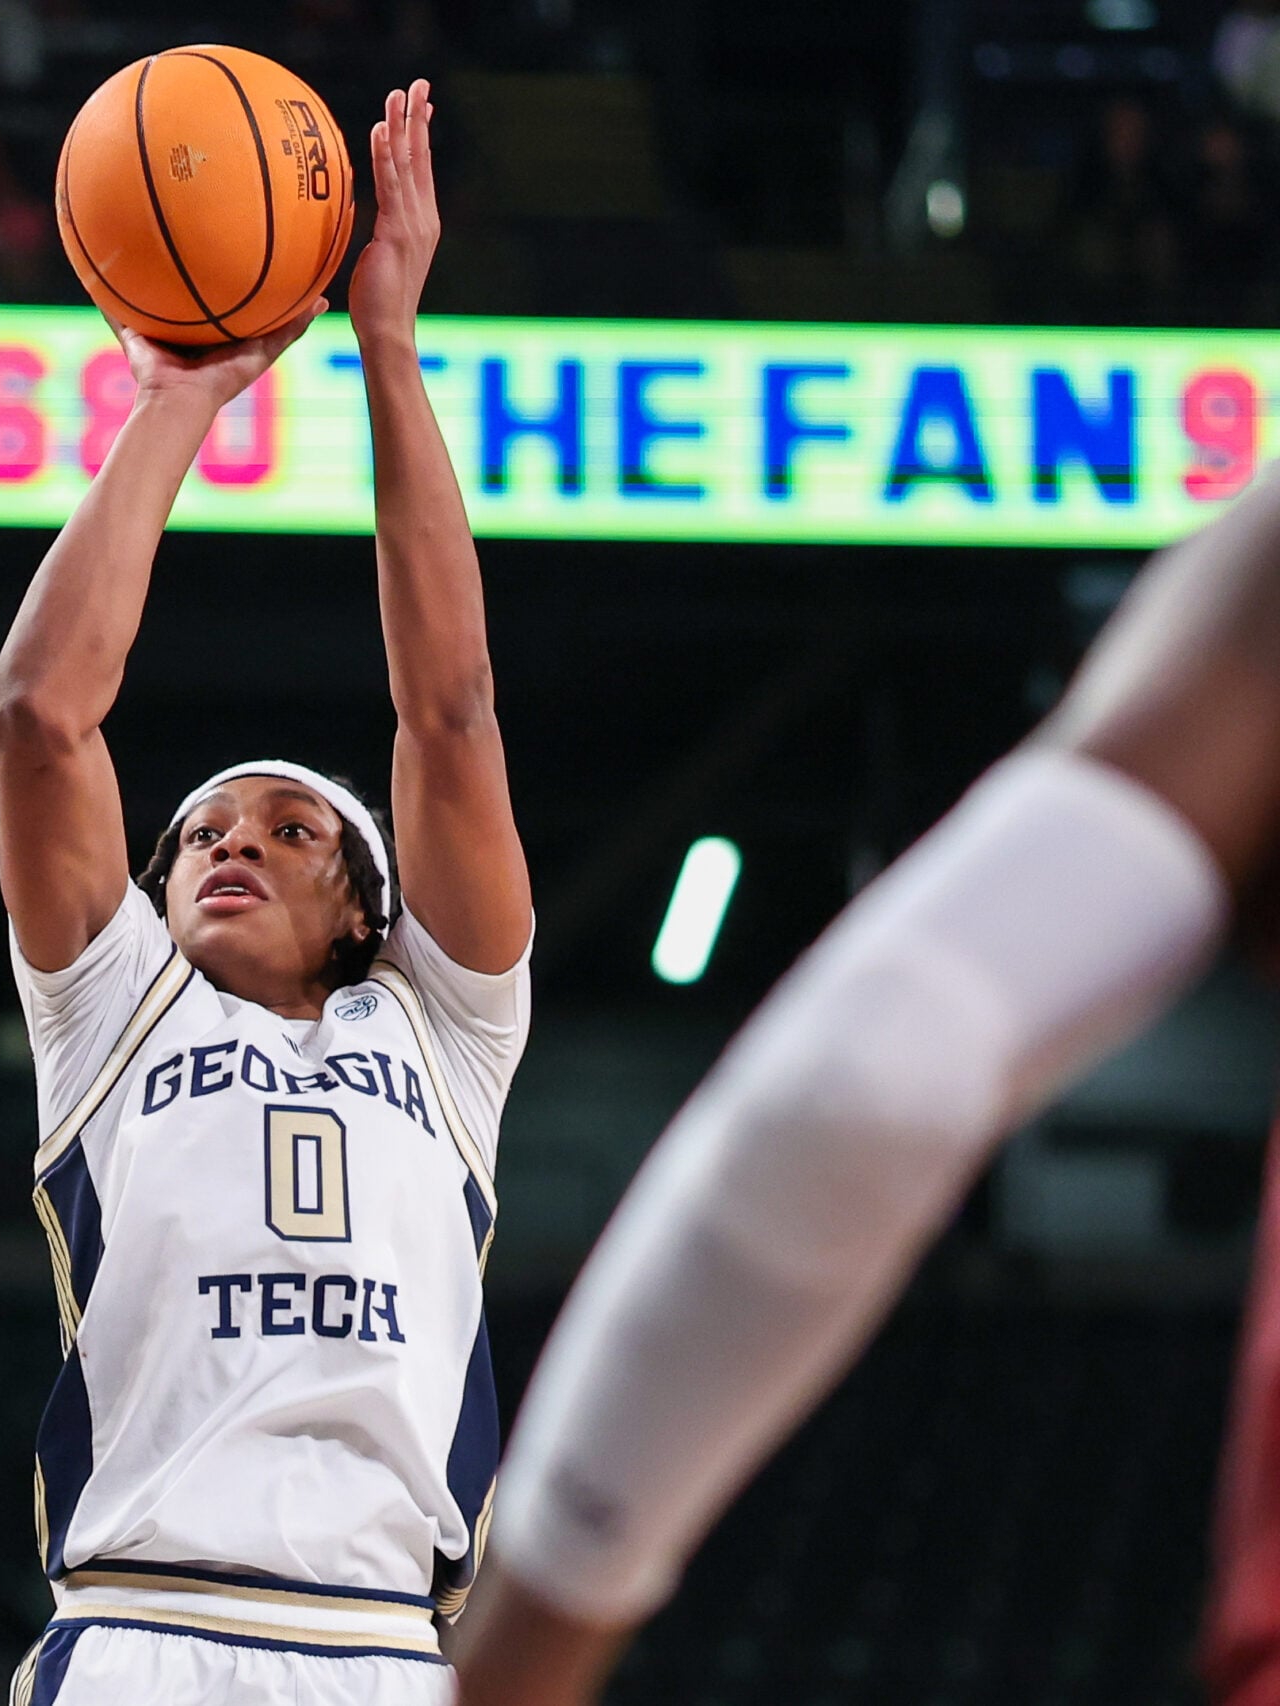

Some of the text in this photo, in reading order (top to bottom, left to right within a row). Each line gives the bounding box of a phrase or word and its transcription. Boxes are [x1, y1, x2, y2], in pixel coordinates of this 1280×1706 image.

[288, 99, 330, 201] PRO
[292, 141, 305, 171] GAME
[297, 173, 306, 201] BALL
[264, 1103, 352, 1243] 0
[198, 1272, 406, 1344] TECH
